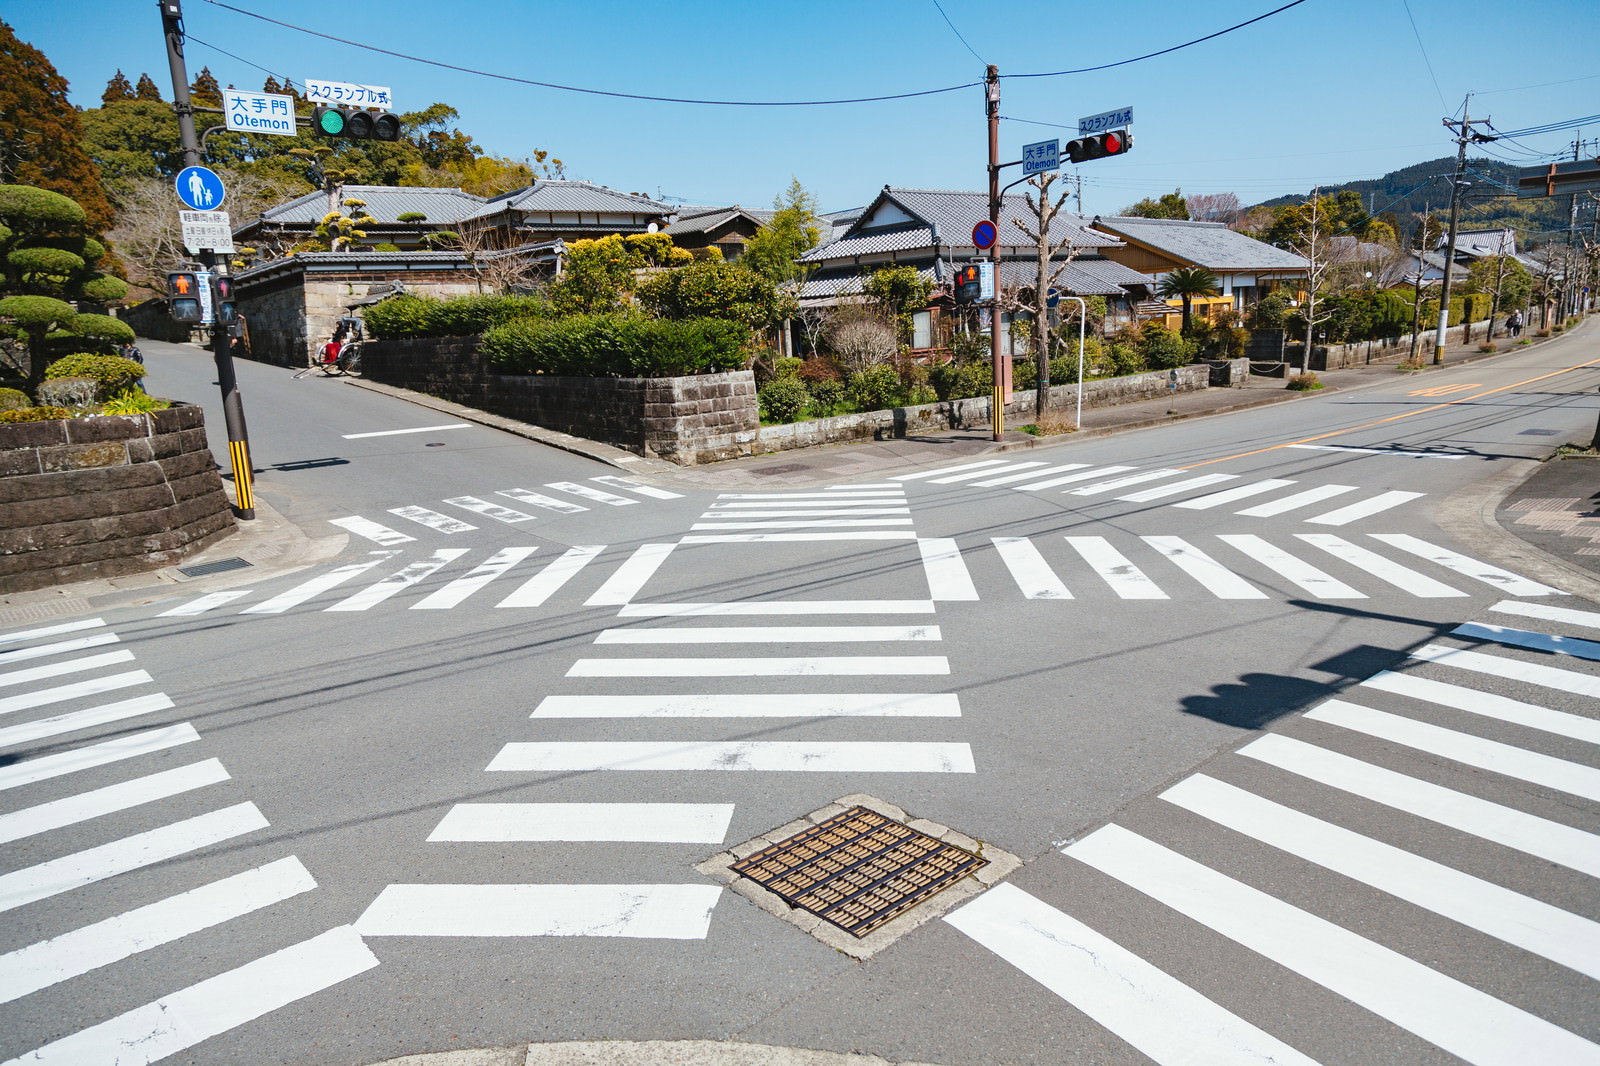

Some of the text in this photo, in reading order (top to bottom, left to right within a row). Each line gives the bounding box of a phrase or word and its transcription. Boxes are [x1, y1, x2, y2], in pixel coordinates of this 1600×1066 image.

[311, 86, 388, 104] スクランブル式
[232, 96, 288, 116] 大手門
[233, 113, 290, 130] Otemon
[1081, 110, 1131, 132] スクランブル式
[1026, 143, 1056, 159] 大手門
[1026, 159, 1056, 170] Otemon
